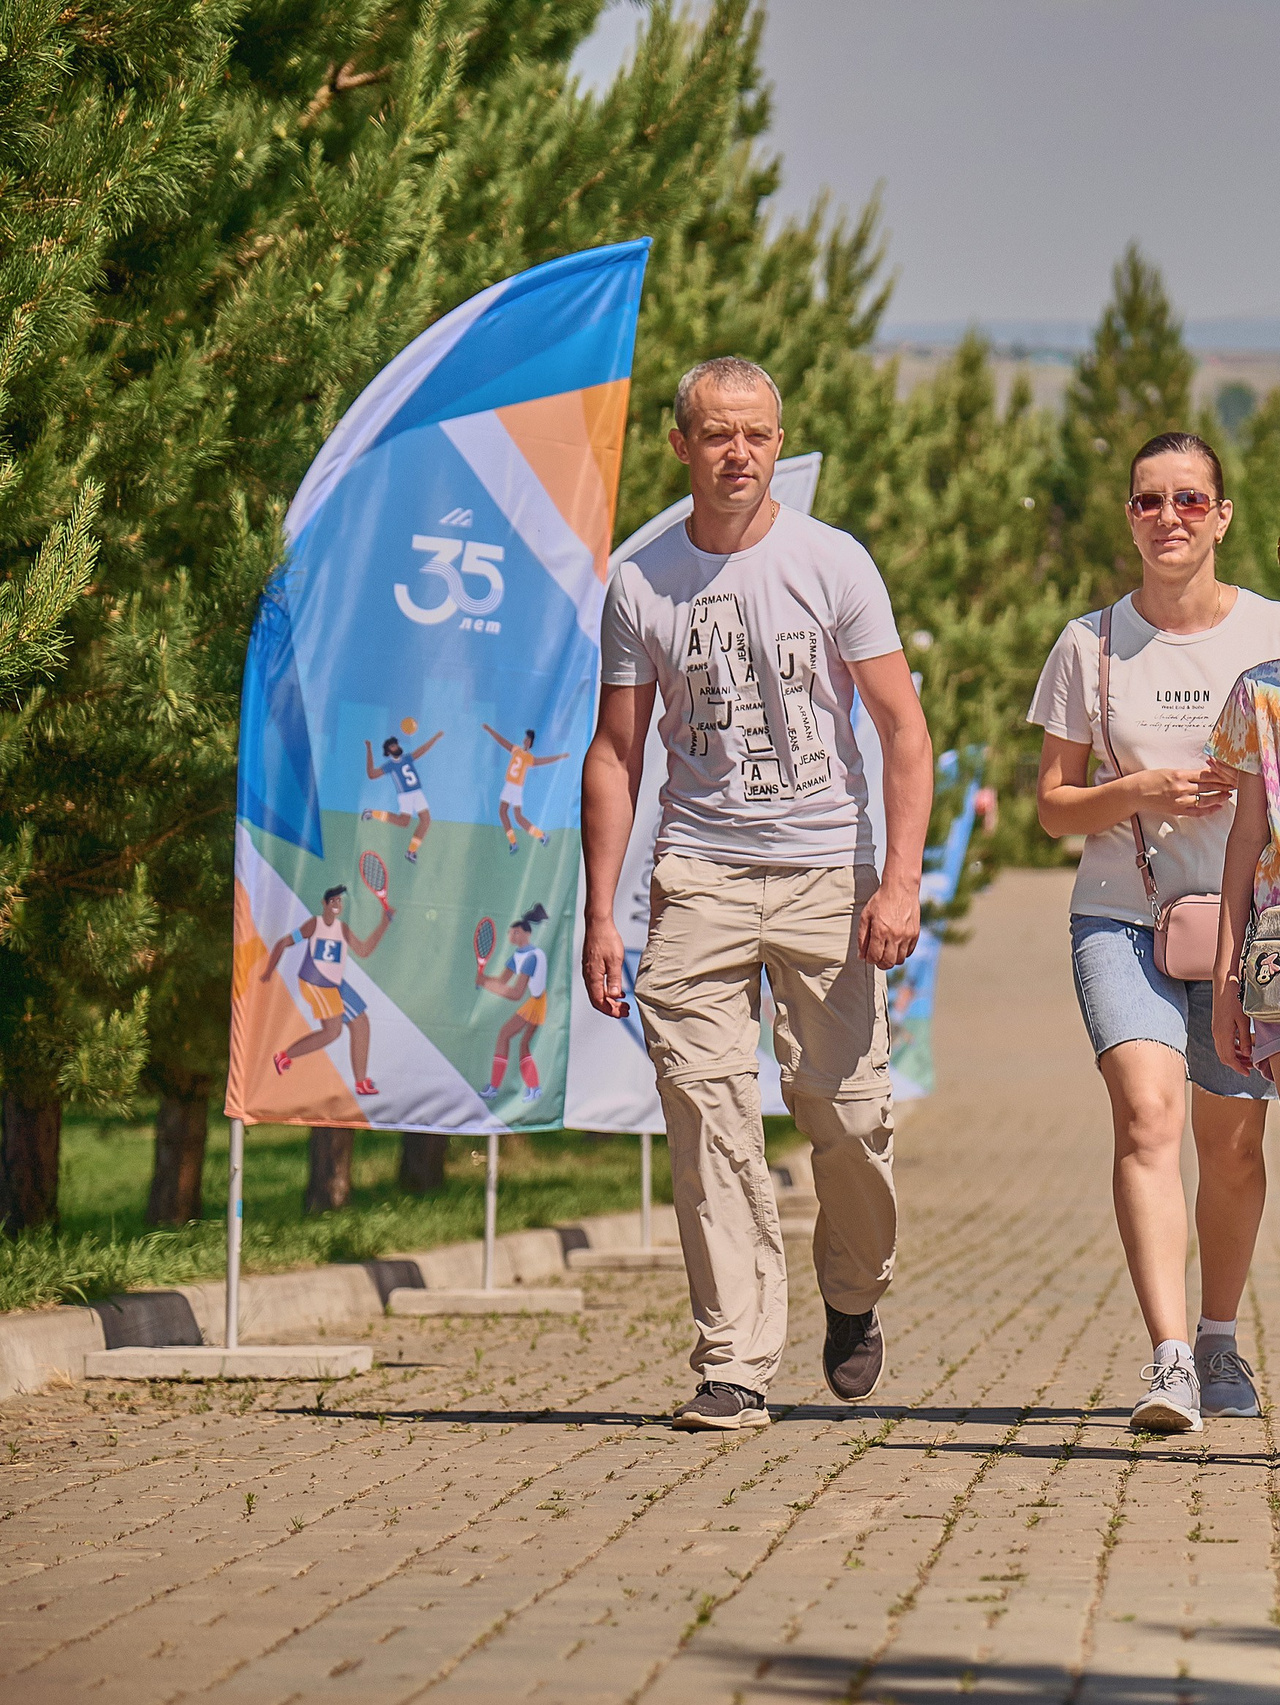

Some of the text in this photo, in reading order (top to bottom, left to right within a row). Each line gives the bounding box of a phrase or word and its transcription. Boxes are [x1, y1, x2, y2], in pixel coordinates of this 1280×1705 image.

[394, 534, 505, 625] 35
[694, 593, 733, 607] ARMANI
[700, 607, 708, 623] J
[459, 617, 502, 635] лет
[688, 628, 701, 656] A
[721, 632, 732, 652] J
[775, 631, 805, 642] JEANS
[736, 633, 747, 662] JEANS
[808, 631, 817, 670] ARMANI
[686, 662, 709, 673] JEANS
[745, 664, 755, 682] A
[780, 653, 795, 680] J
[700, 686, 731, 696] ARMANI
[1156, 690, 1210, 702] LONDON
[717, 700, 732, 730] J
[734, 701, 766, 712] ARMANI
[742, 726, 770, 737] JEANS
[797, 704, 814, 742] ARMANI
[787, 726, 800, 752] JEANS
[799, 749, 826, 766] JEANS
[751, 764, 762, 781] A
[747, 784, 779, 796] JEANS
[795, 775, 827, 792] ARMANI
